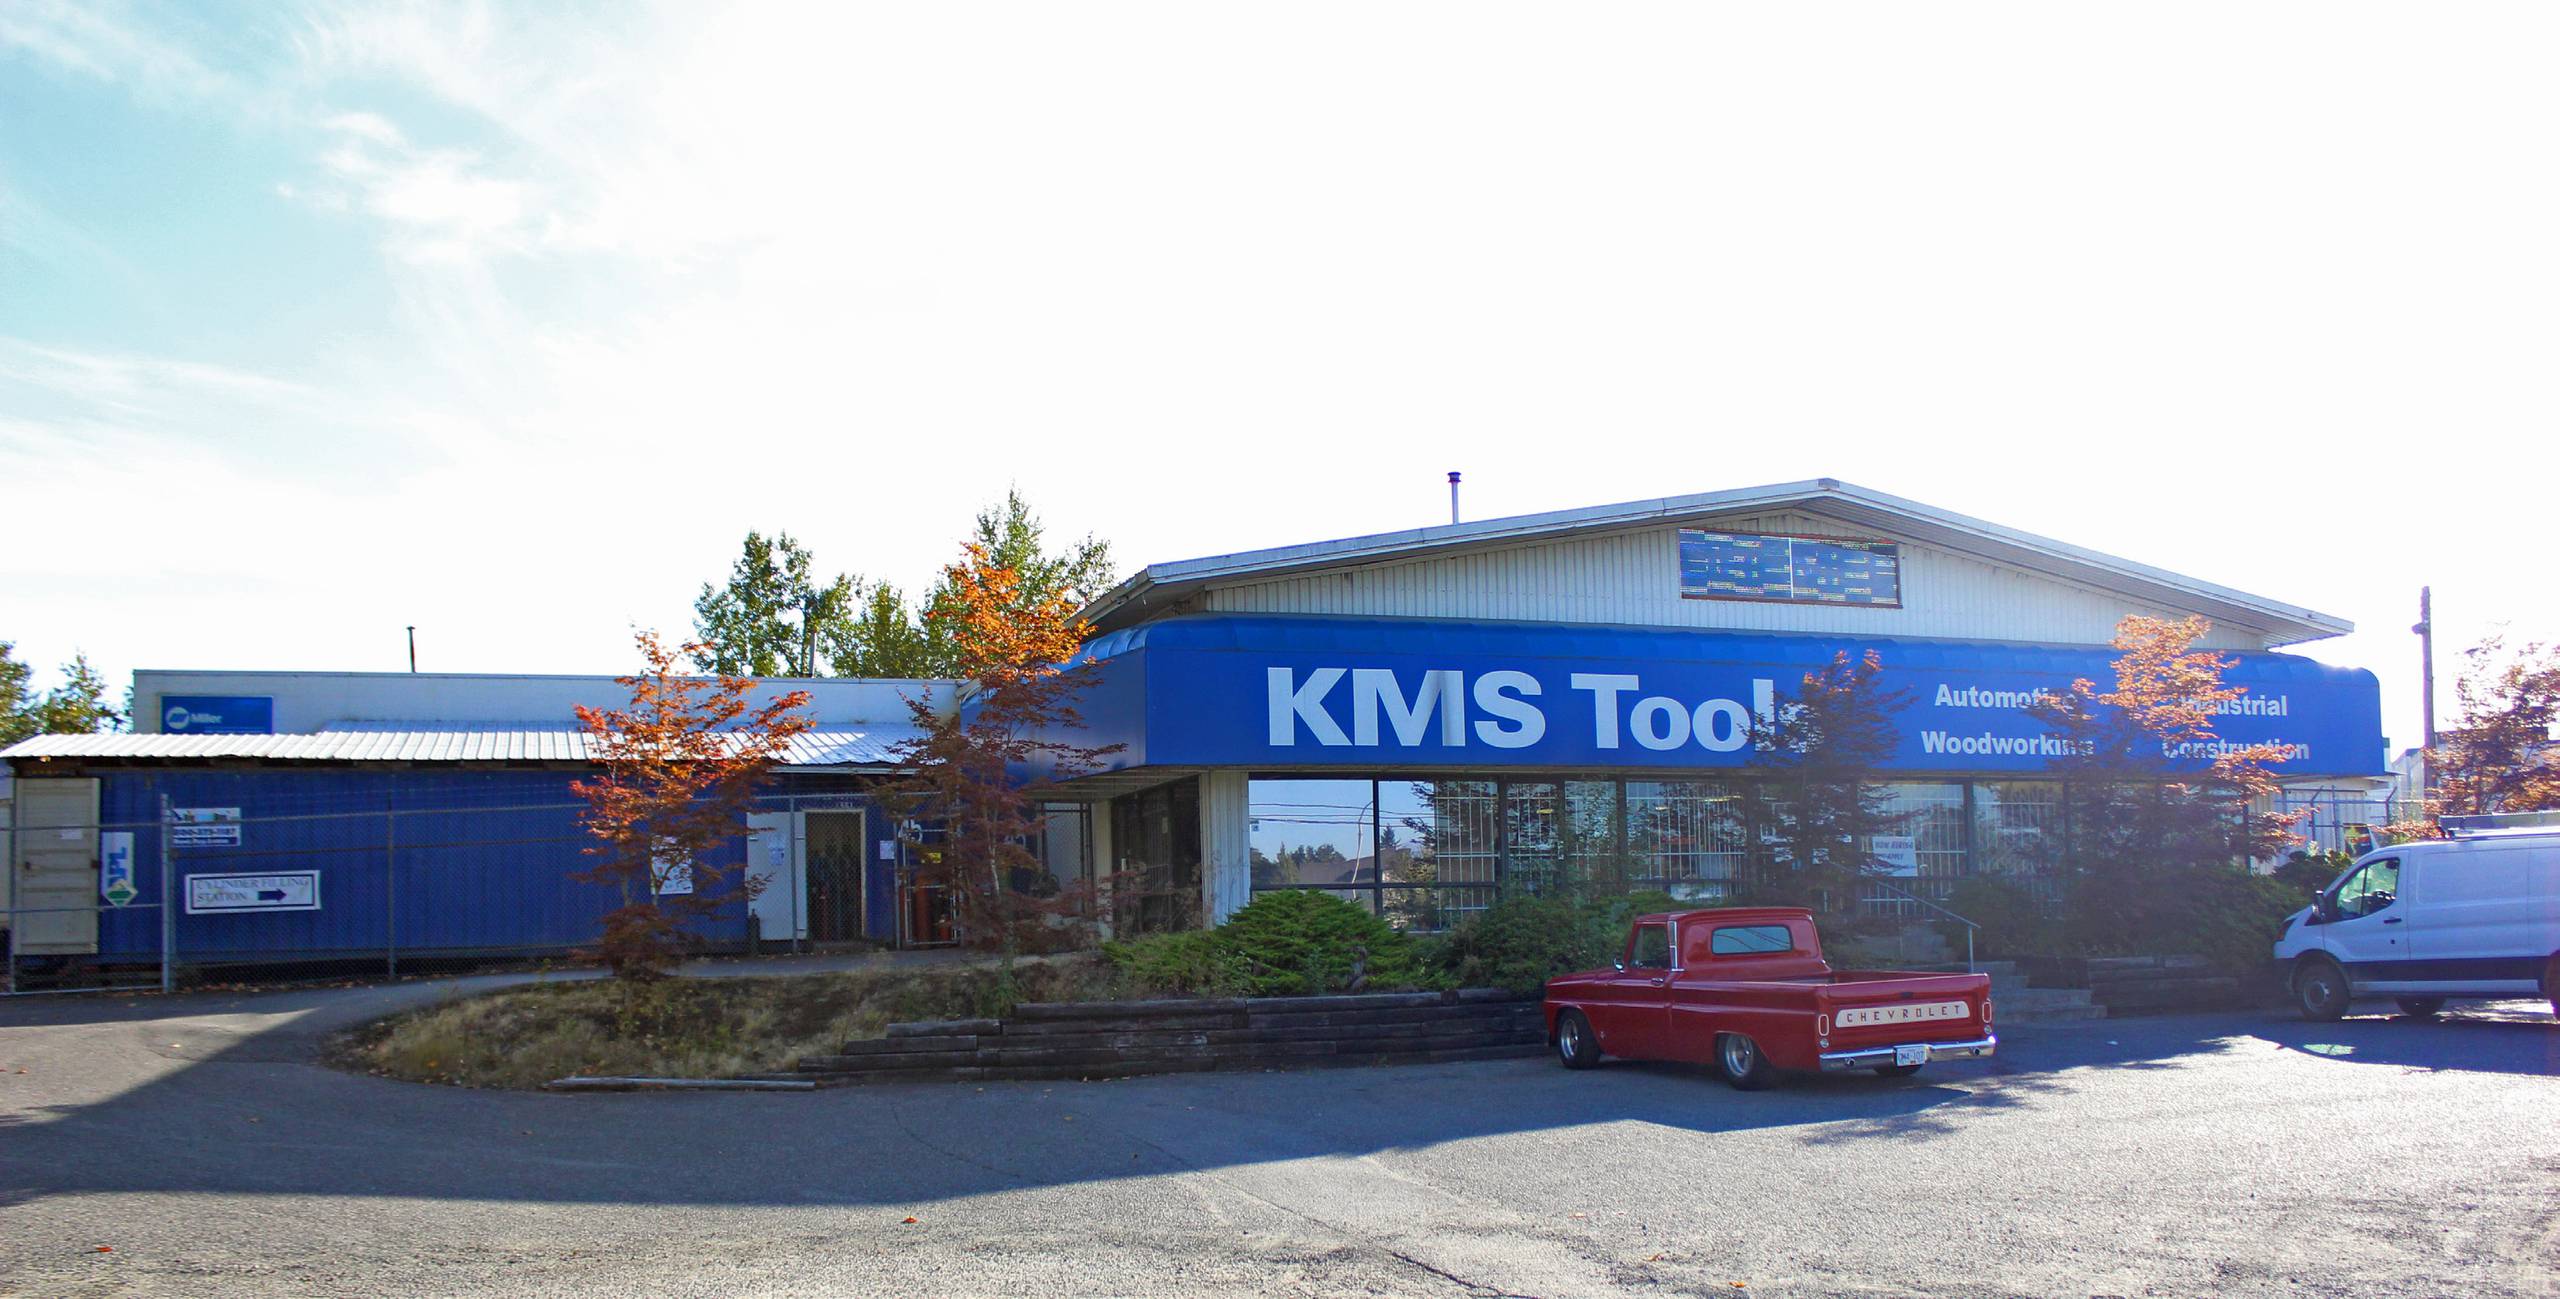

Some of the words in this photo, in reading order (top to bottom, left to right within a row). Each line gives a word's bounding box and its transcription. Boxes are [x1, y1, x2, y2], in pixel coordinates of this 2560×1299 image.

[1267, 666, 1546, 749] KMS
[196, 879, 259, 890] CYLINDER
[262, 877, 310, 888] FILLING
[197, 891, 248, 902] STATION
[1846, 1005, 1960, 1023] CHEVROLET
